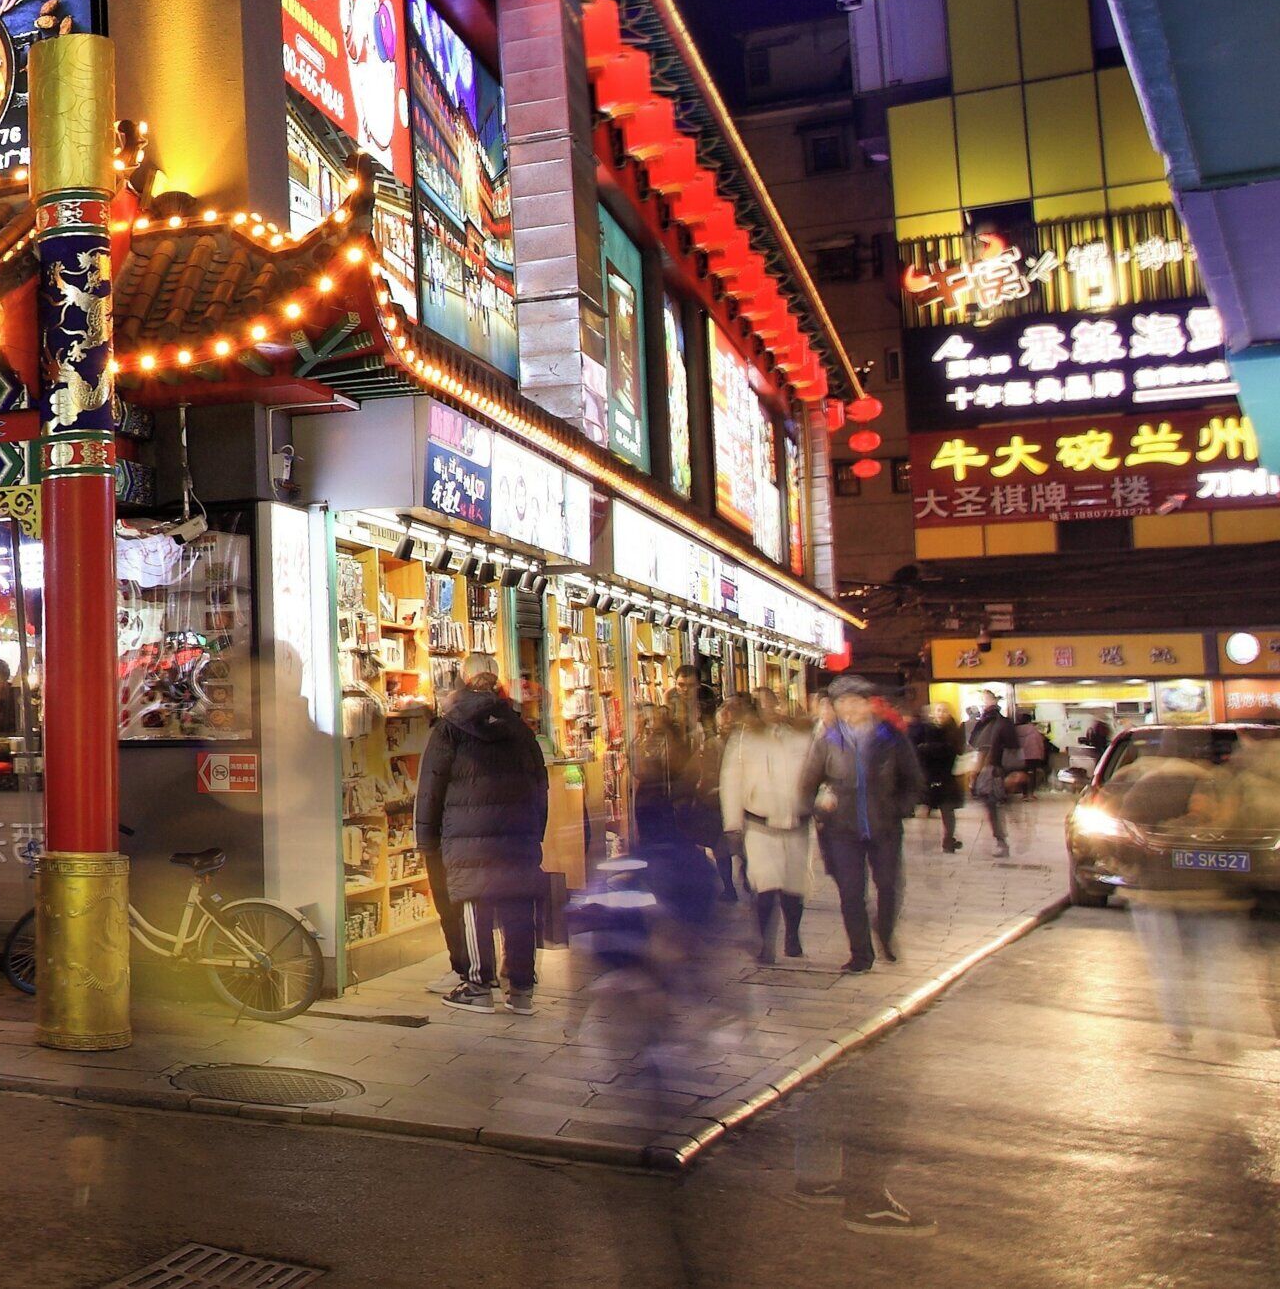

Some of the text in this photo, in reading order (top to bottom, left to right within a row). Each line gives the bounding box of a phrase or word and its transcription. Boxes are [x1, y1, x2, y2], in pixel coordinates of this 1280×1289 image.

[931, 415, 1260, 482] 牛大碗兰州
[915, 475, 1151, 520] 大圣棋牌二楼
[230, 776, 257, 784] 禁止停车
[1198, 853, 1248, 869] SK527
